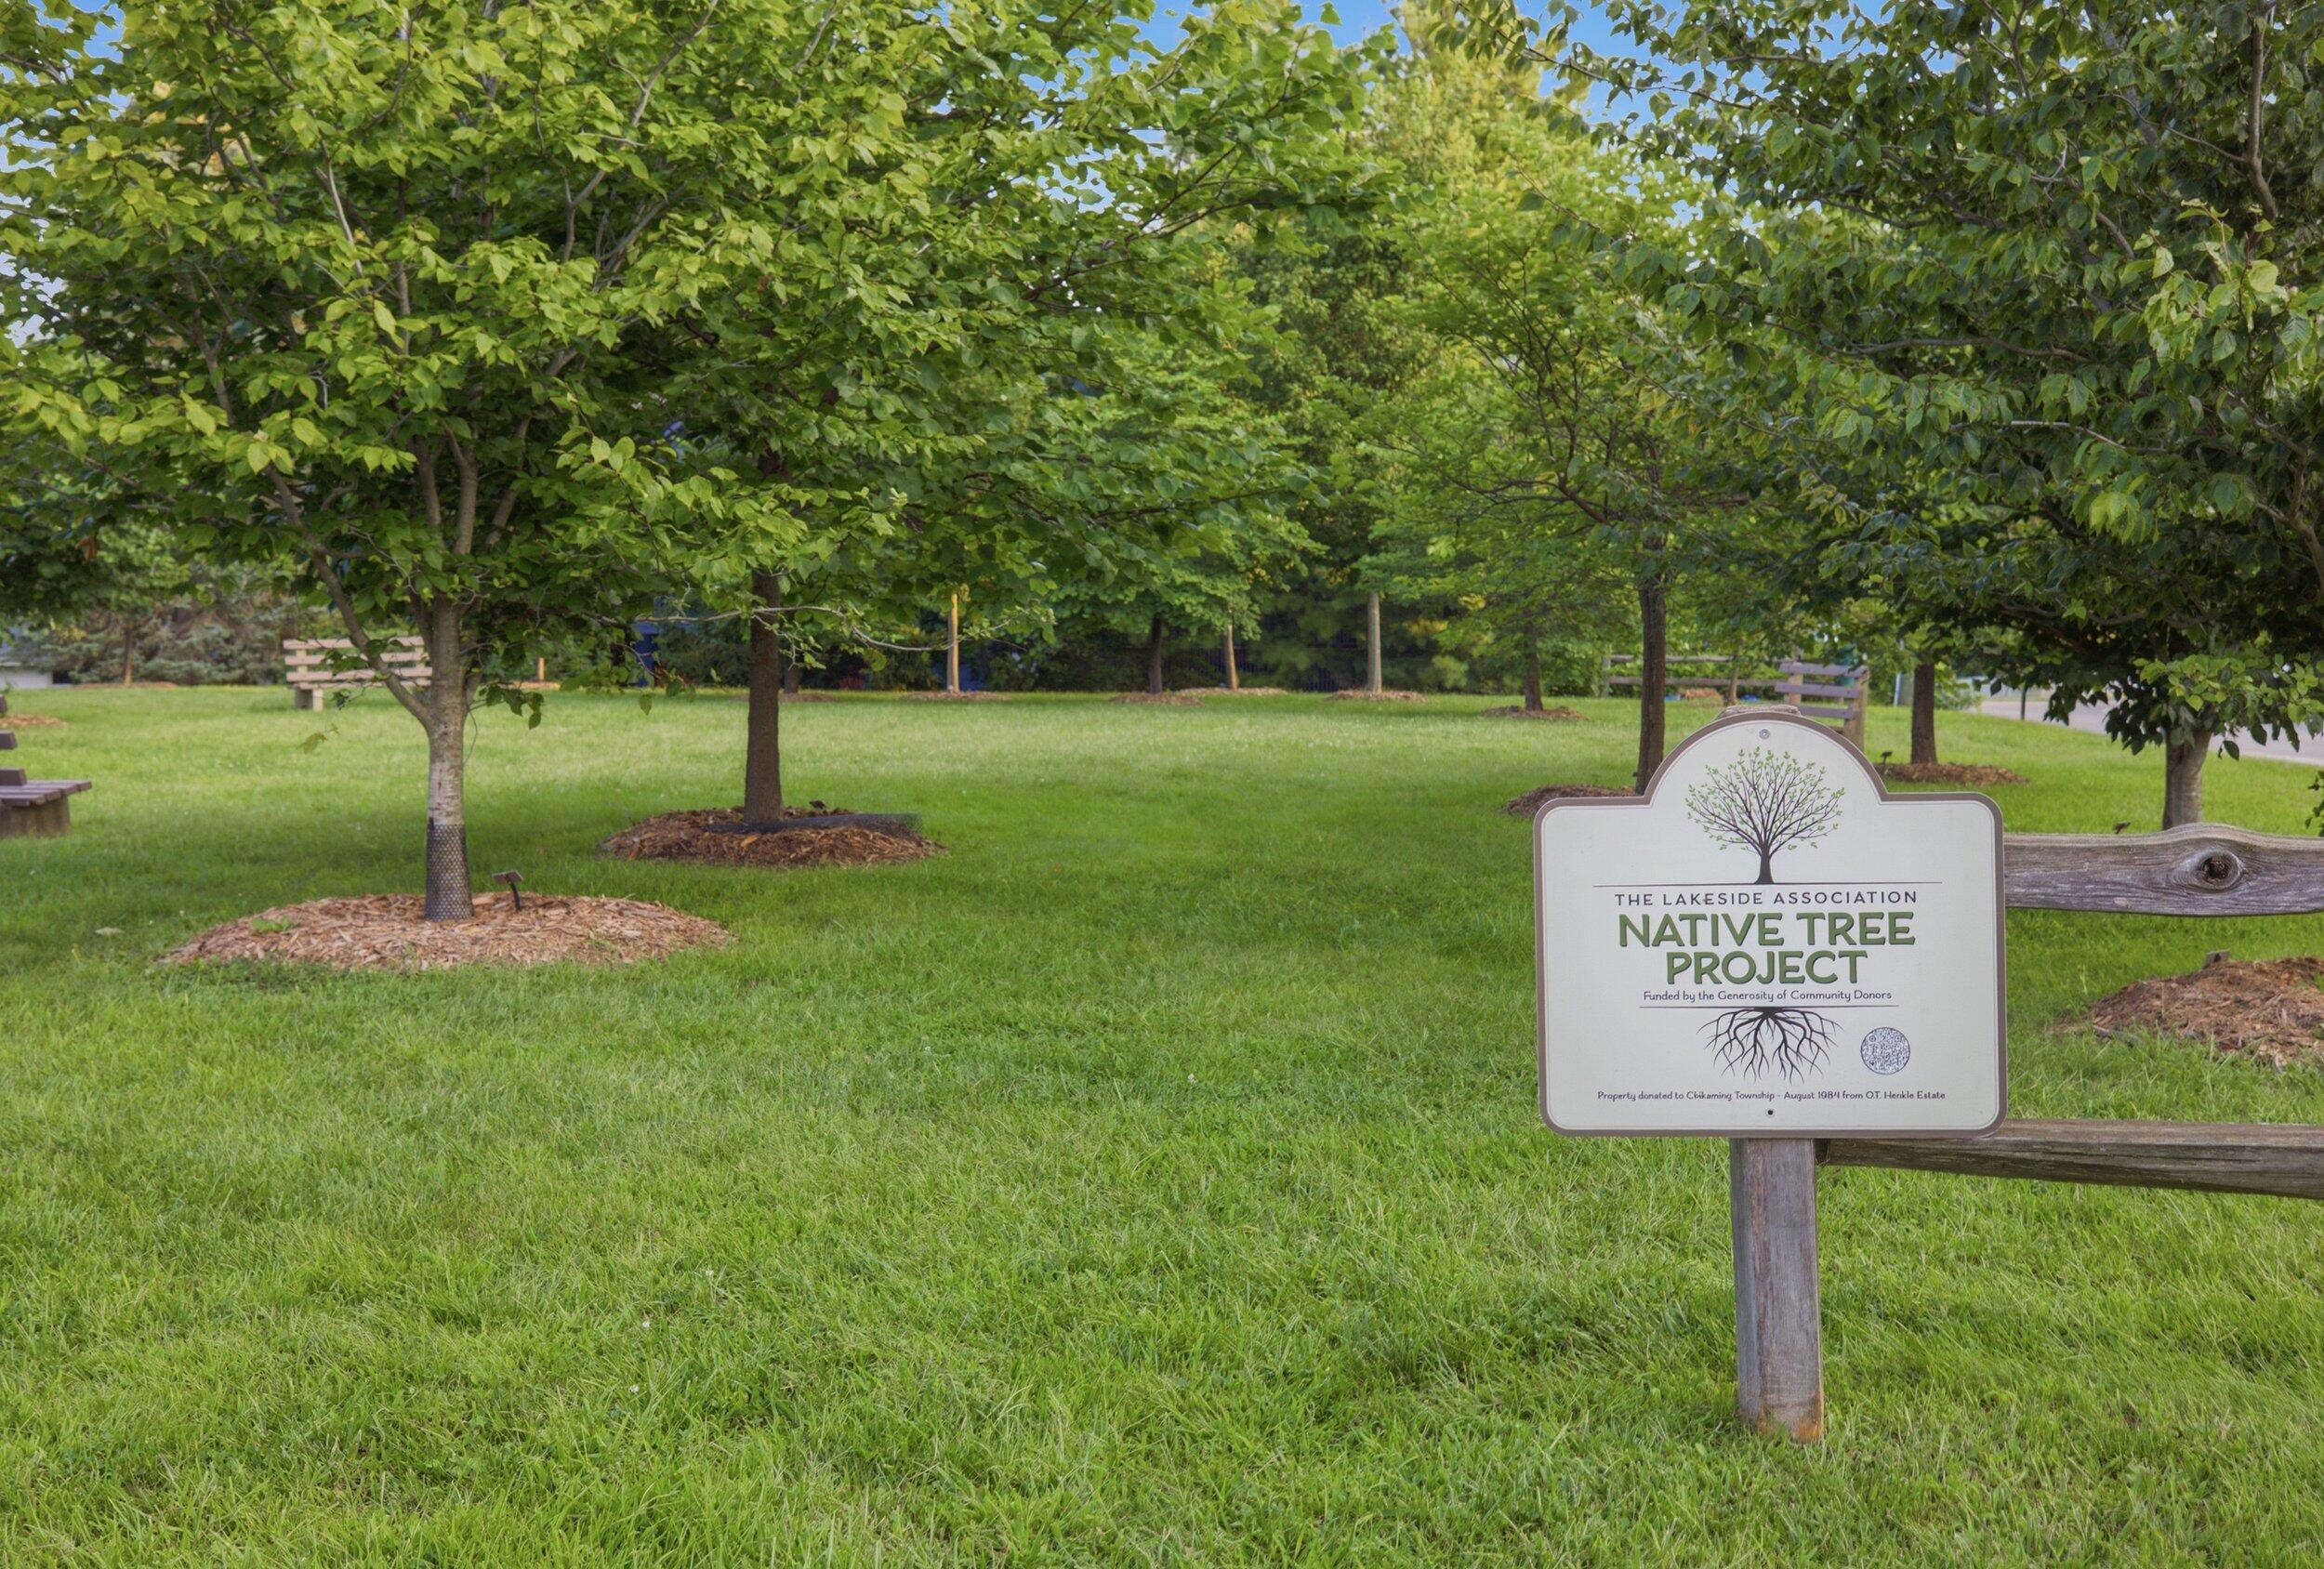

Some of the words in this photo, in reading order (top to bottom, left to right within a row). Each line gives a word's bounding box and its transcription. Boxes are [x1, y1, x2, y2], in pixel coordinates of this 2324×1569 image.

[1614, 893, 1654, 906] THE
[1662, 892, 1763, 906] LAKESIDE
[1773, 890, 1917, 904] ASSOCIATION
[1618, 912, 1785, 947] NATIVE
[1795, 912, 1917, 946] TREE
[1666, 949, 1868, 985] PROJECT
[1643, 990, 1681, 1001] Funded
[1682, 991, 1696, 1004] by
[1697, 990, 1715, 1001] the
[1717, 990, 1775, 1003] Generosity
[1776, 989, 1788, 1000] of
[1789, 989, 1852, 1003] Community
[1854, 989, 1893, 1000] Donors
[1597, 1090, 1637, 1102] Property
[1637, 1090, 1673, 1101] donated
[1674, 1091, 1684, 1101] to
[1734, 1090, 1776, 1102] Township
[1783, 1090, 1816, 1102] August
[1817, 1090, 1841, 1101] 1984
[1842, 1090, 1864, 1101] from
[1883, 1090, 1915, 1101] Henkle
[1916, 1090, 1947, 1101] Estate
